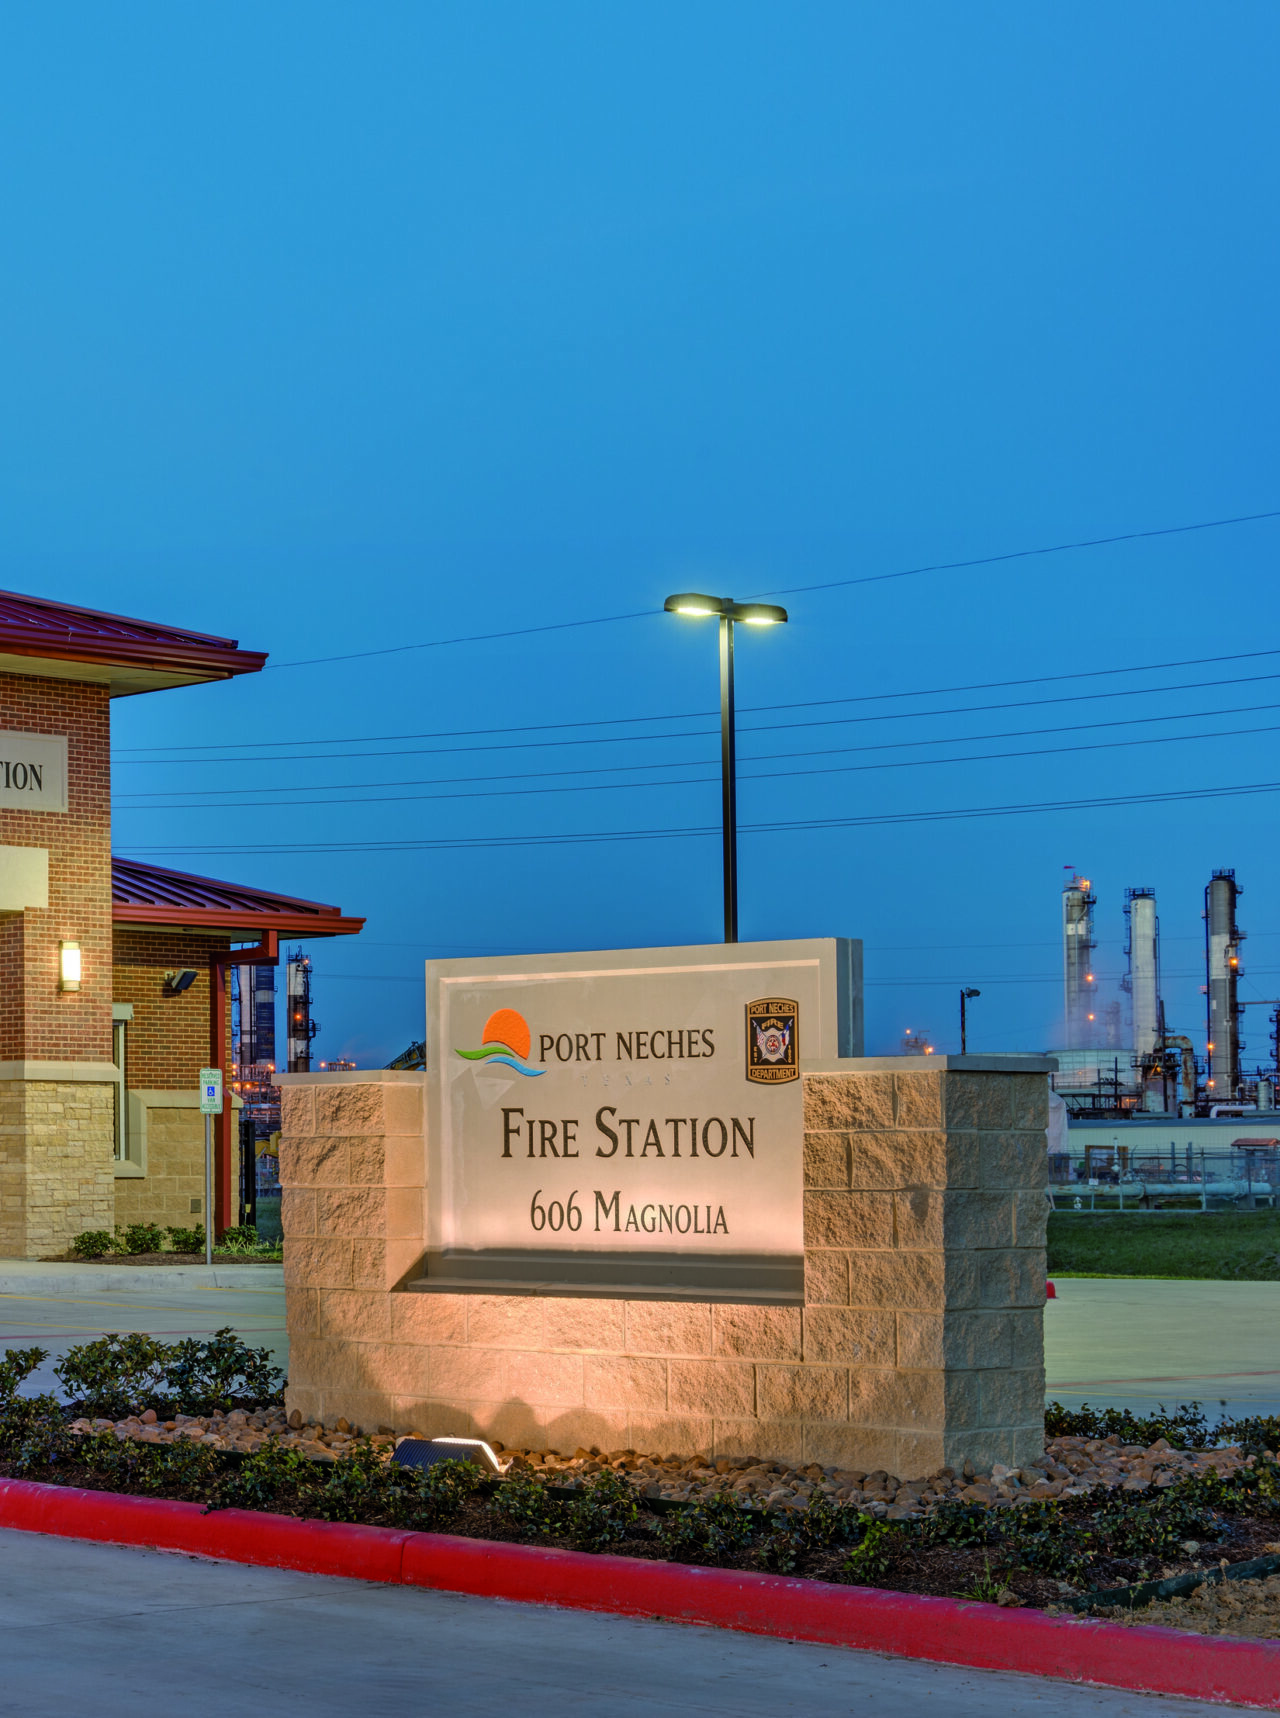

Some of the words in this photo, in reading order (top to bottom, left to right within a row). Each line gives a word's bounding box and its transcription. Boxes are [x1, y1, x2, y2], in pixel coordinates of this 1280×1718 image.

[750, 1004, 767, 1014] PORT
[769, 1003, 794, 1014] NECHES
[761, 1018, 784, 1030] FIRE
[539, 1032, 607, 1063] PORT
[616, 1028, 716, 1061] NECHES
[751, 1068, 795, 1080] DEPARTMENT
[500, 1107, 580, 1158] FIRE
[595, 1105, 756, 1159] STATION
[530, 1189, 583, 1232] 606
[593, 1190, 730, 1234] MAGNOLIA
